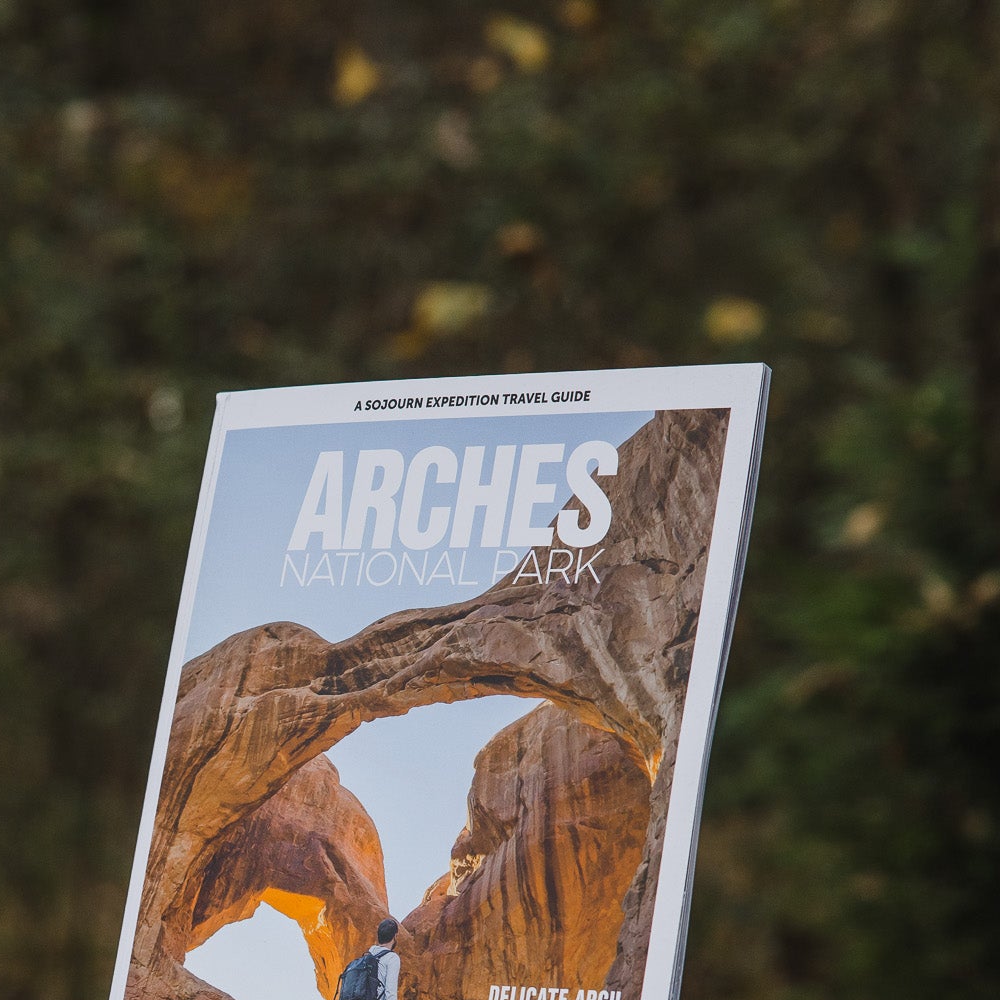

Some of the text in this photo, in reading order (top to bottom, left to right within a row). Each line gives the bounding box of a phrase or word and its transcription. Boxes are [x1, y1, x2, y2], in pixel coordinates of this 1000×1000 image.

[354, 391, 591, 411] A SOJOURN EXPEDITION TRAVEL GUIDE
[287, 441, 619, 550] ARCHES
[280, 549, 605, 587] NATIONAL PARK
